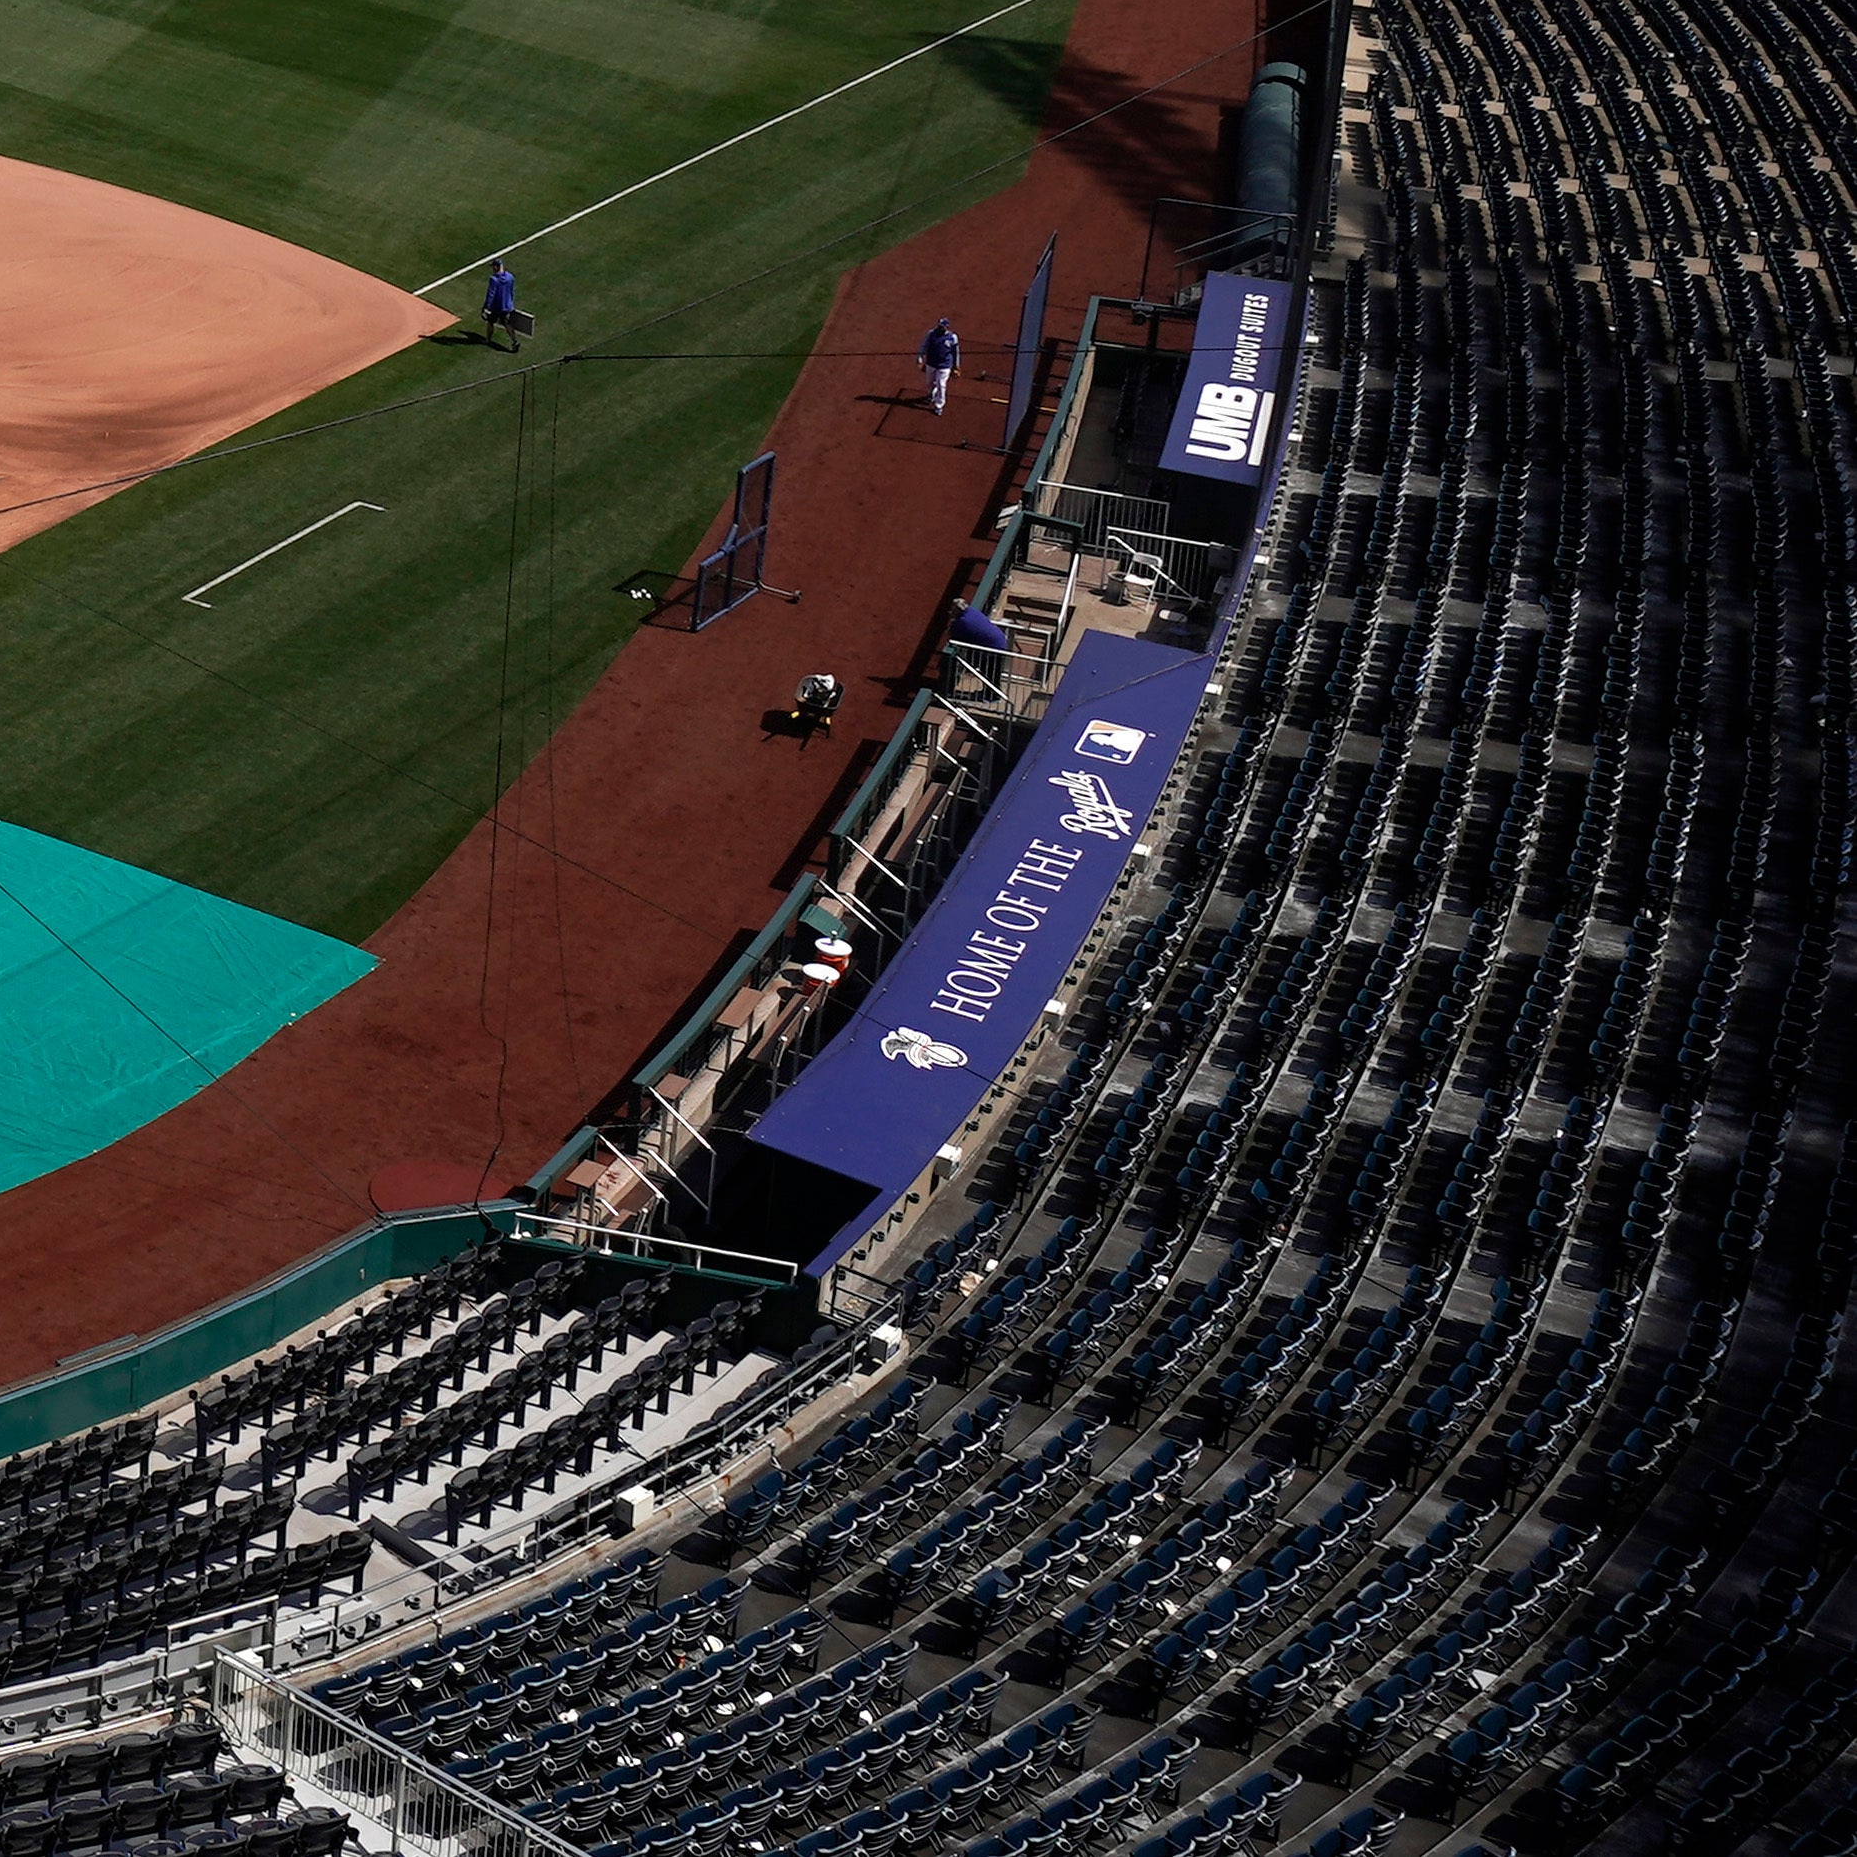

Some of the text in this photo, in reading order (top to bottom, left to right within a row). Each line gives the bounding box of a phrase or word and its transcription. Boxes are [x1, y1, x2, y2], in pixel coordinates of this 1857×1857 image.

[1185, 292, 1270, 462] UMB DUGOUT SUITES
[930, 769, 1133, 1023] HOME OF THE Royals
